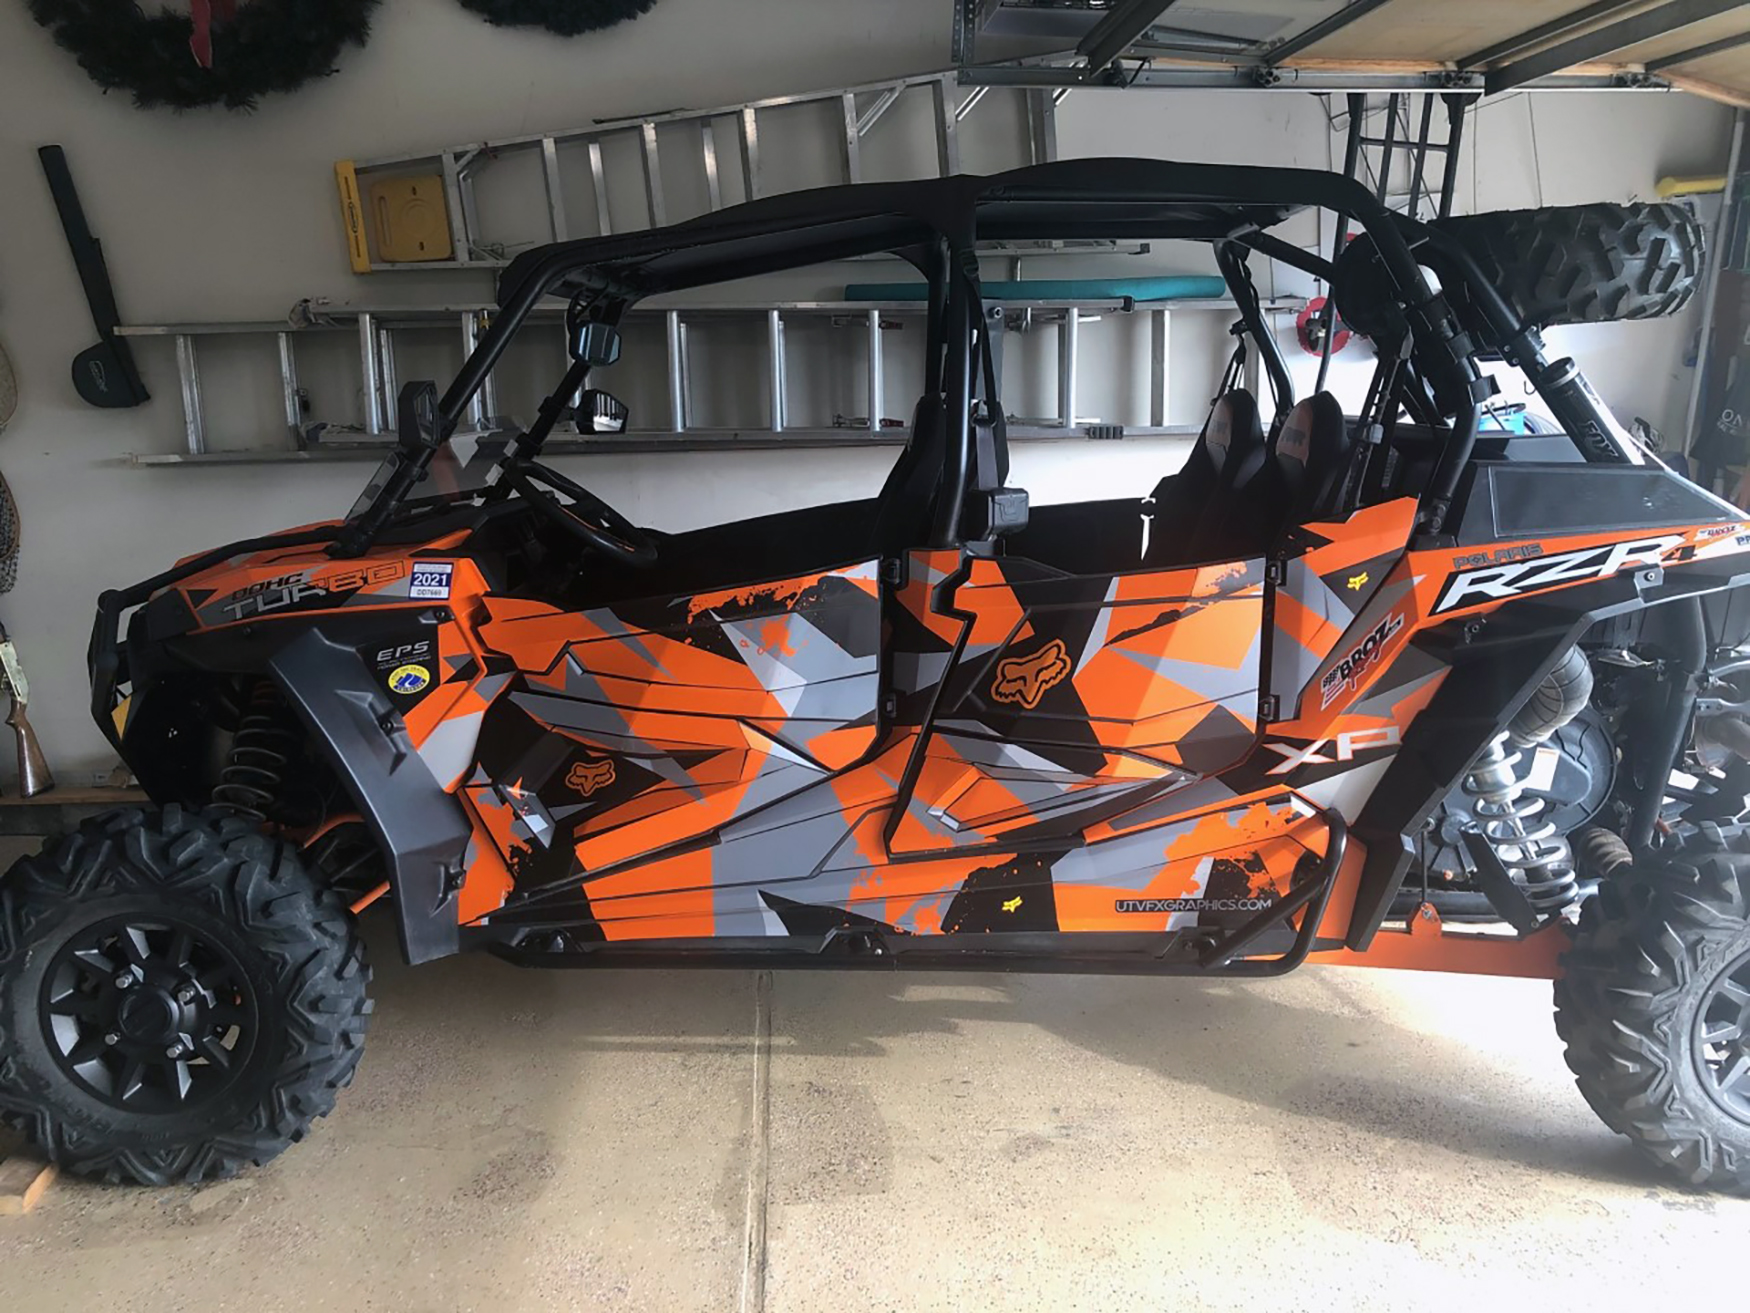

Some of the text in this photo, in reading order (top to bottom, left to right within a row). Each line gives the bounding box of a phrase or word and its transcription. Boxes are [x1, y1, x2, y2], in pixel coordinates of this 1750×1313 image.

[1453, 543, 1544, 570] POLARIS
[413, 573, 447, 586] 2021
[1433, 533, 1697, 614] RZR 4
[223, 560, 406, 620] TURBO
[376, 640, 430, 661] EPS
[1261, 725, 1402, 776] XP
[1115, 899, 1272, 912] UTVFXGRAPHICS.COM
